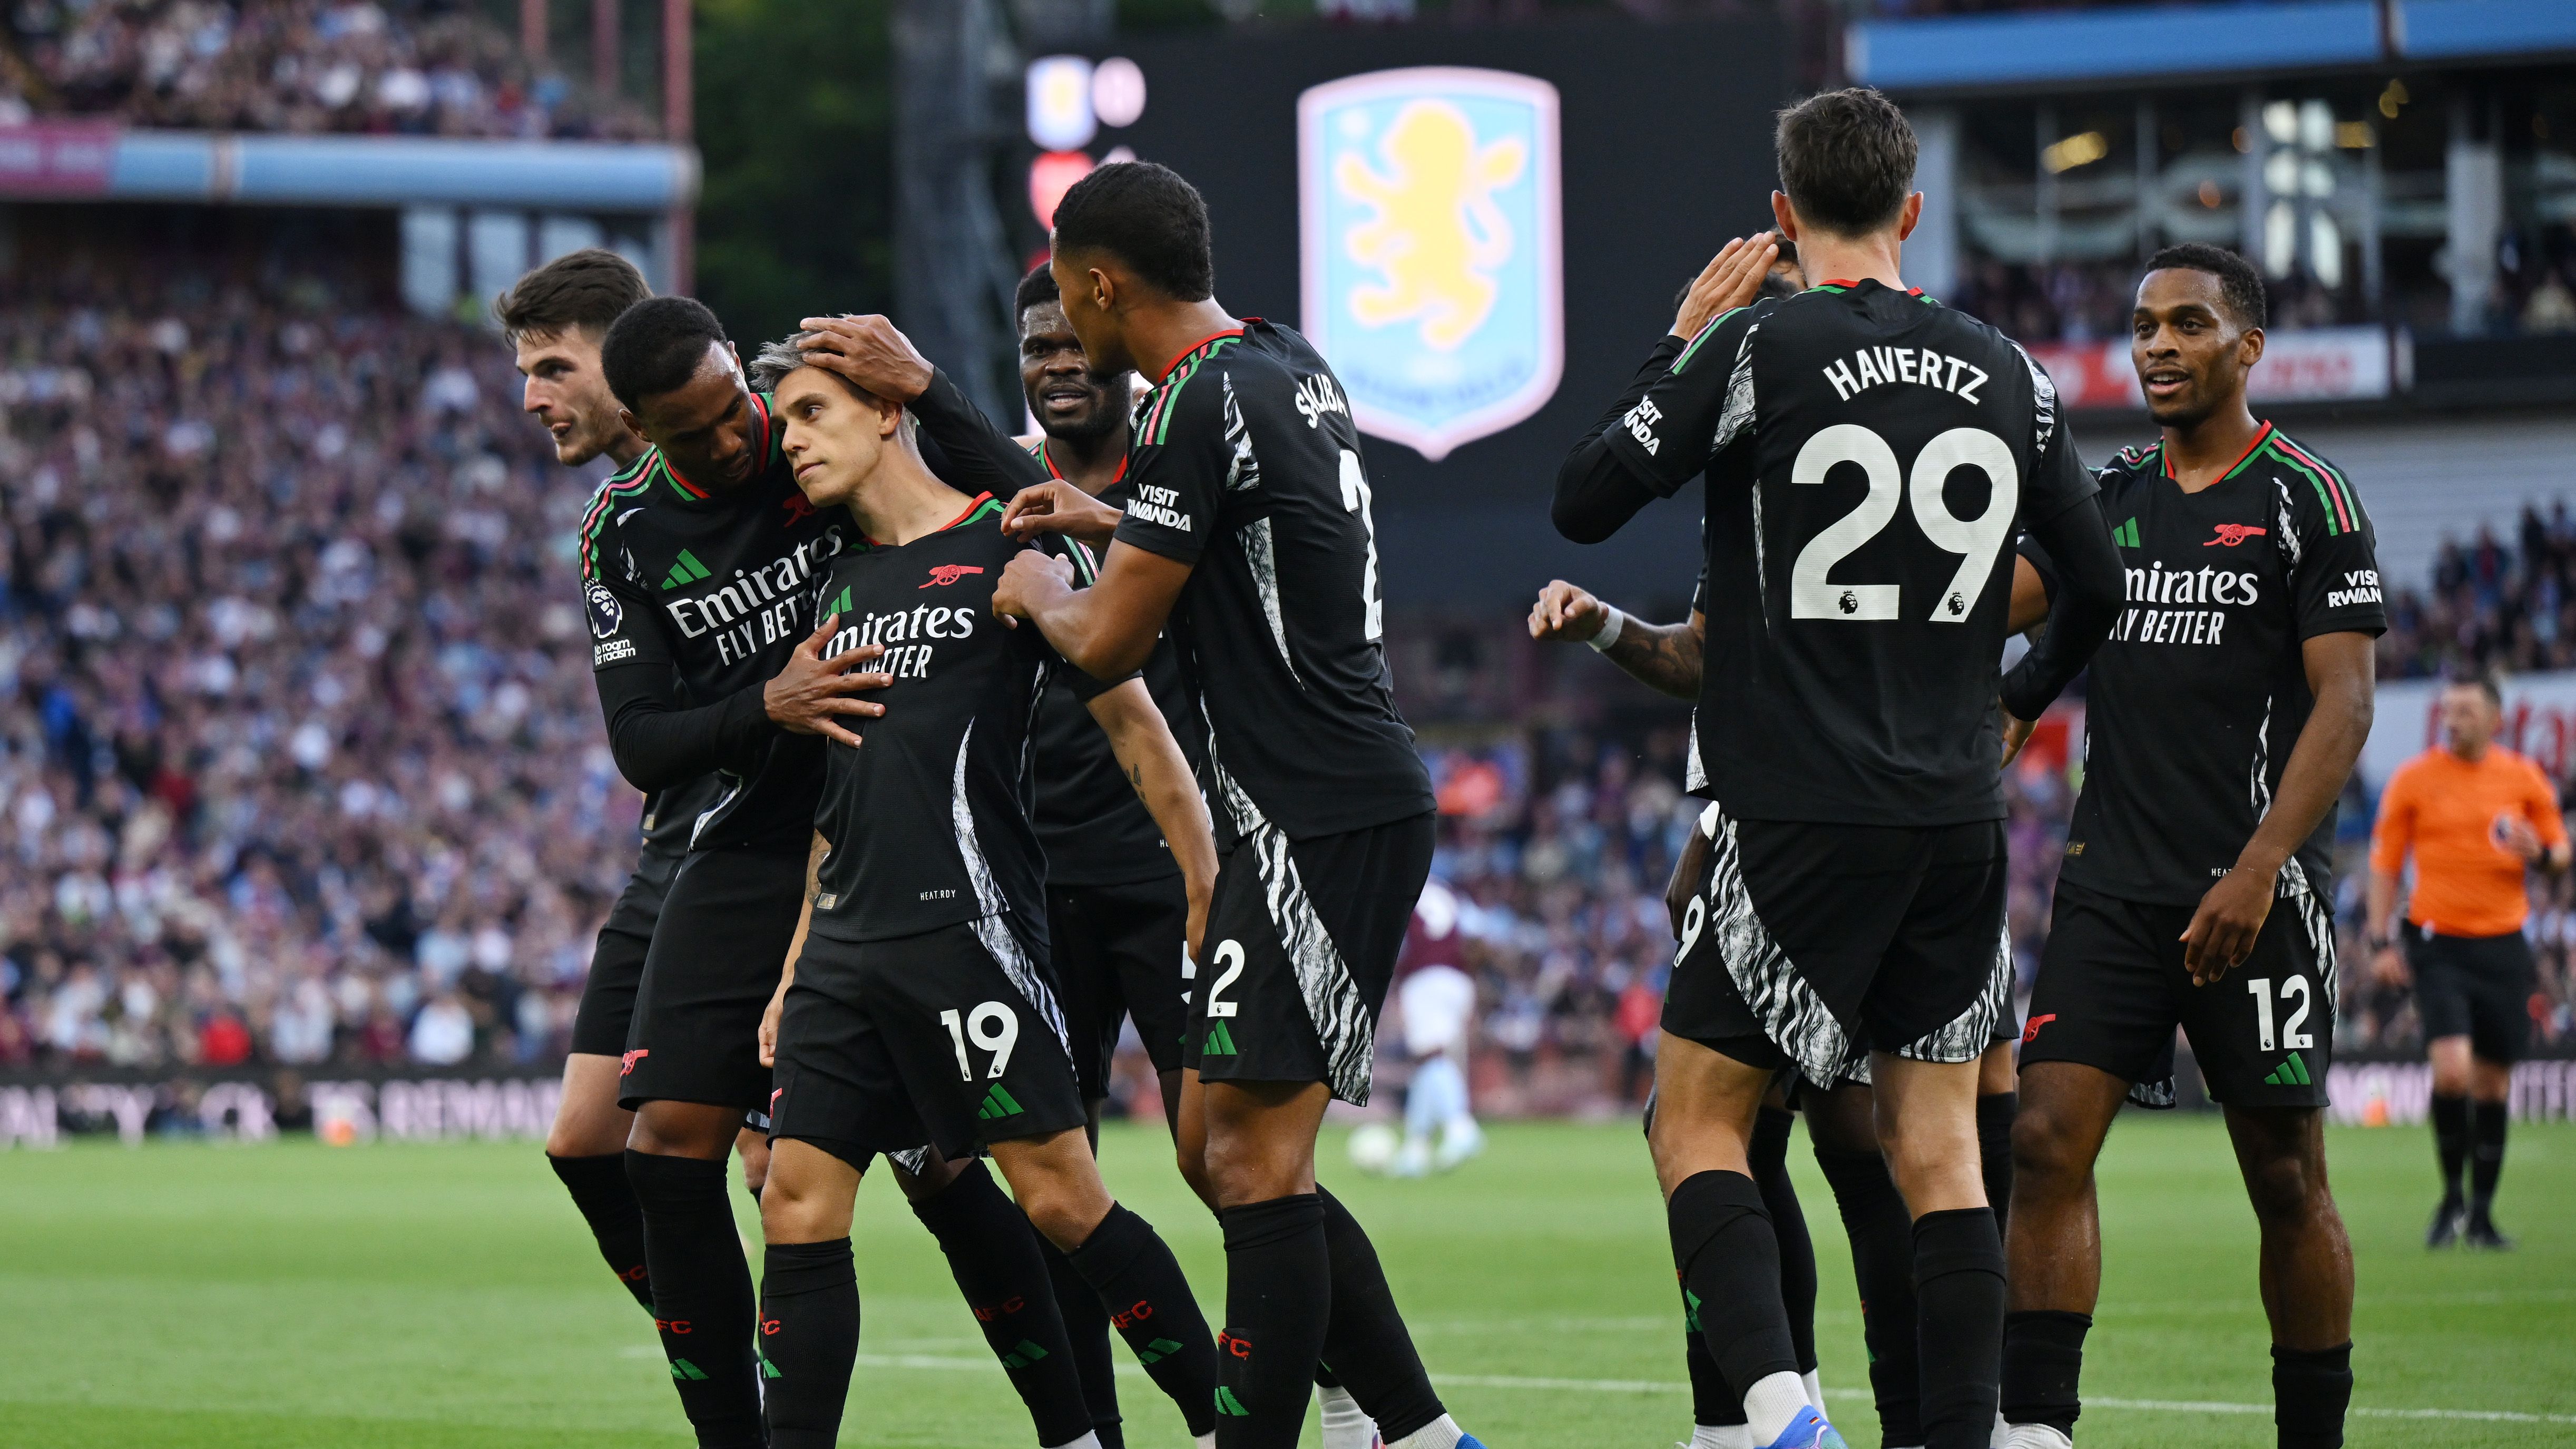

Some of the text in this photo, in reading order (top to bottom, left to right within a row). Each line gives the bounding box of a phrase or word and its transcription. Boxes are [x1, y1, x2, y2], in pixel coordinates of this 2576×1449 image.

[1822, 346, 1989, 405] HAVERTZ
[1127, 498, 1191, 532] RWANDA
[1138, 483, 1179, 507] VISIT
[1791, 424, 2018, 623] 29
[666, 524, 842, 639] Emirates
[2125, 561, 2258, 606] mirates
[2328, 586, 2382, 608] RWAN
[594, 639, 630, 655] No room
[716, 620, 757, 667] FLY
[825, 602, 975, 660] mirates
[2140, 610, 2225, 645] BETTER
[603, 648, 636, 662] racism
[920, 889, 956, 901] HEAT.RDY
[1207, 939, 1245, 1017] 2
[2248, 974, 2313, 1051] 12
[940, 1001, 1018, 1081] 19
